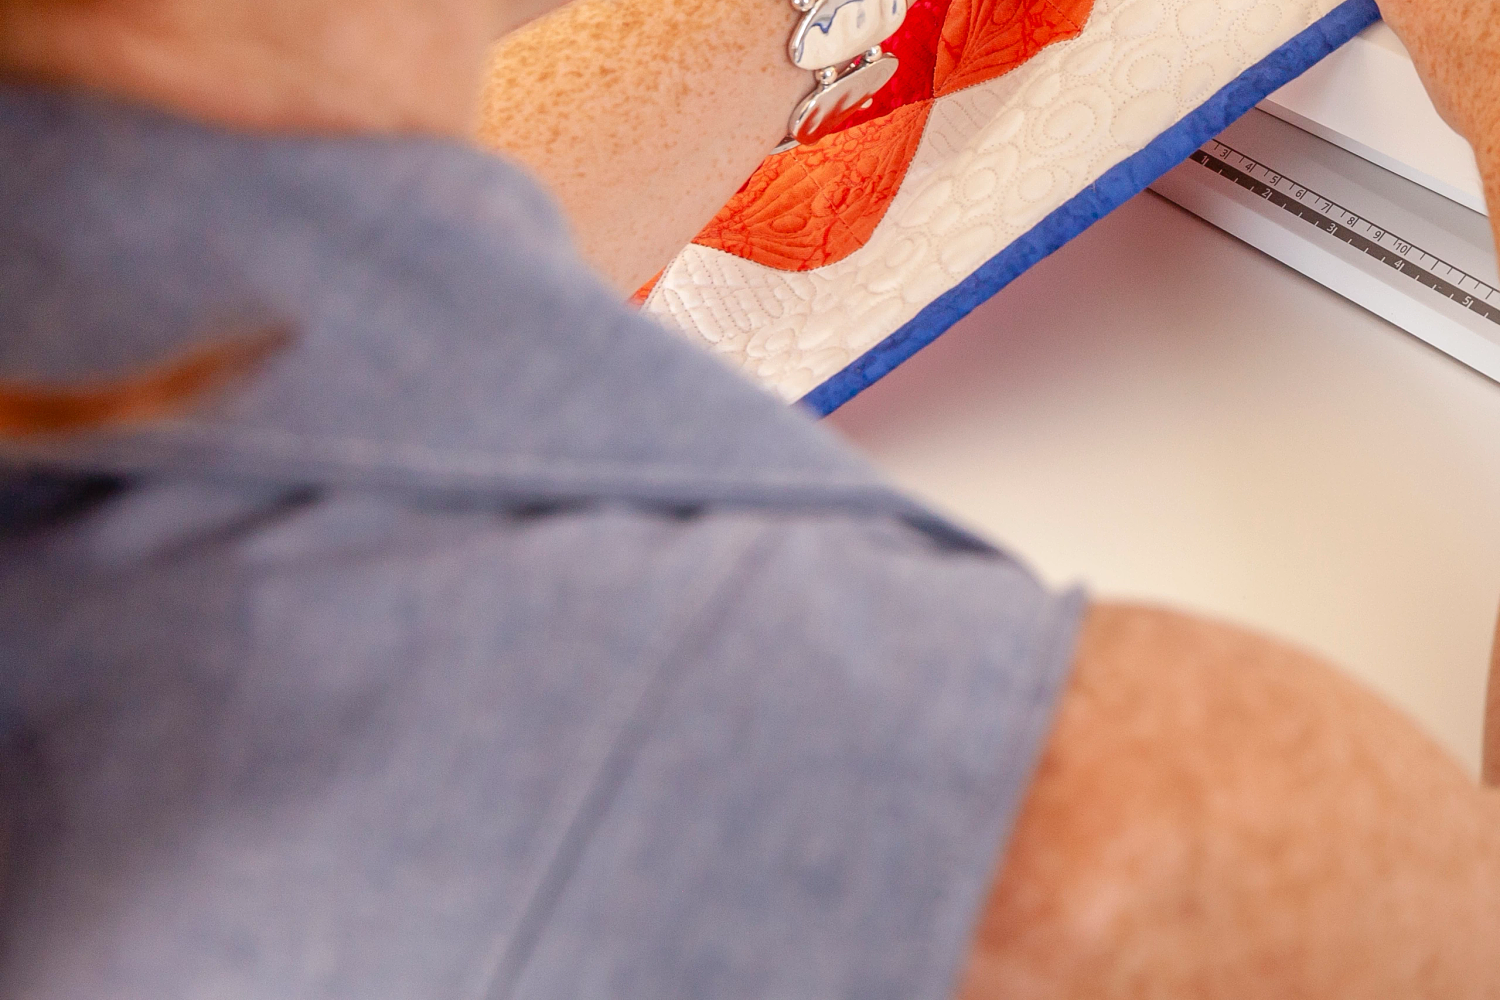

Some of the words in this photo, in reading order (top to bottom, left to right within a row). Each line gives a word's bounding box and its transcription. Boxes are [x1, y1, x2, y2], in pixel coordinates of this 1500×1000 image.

[1219, 149, 1228, 157] 3
[1245, 162, 1254, 171] 4
[1269, 175, 1278, 184] 5
[1295, 189, 1304, 198] 6
[1320, 202, 1330, 211] 7
[1346, 216, 1356, 225] 8
[1372, 230, 1382, 239] 9
[1396, 241, 1408, 253] 10
[1261, 187, 1271, 197] 2
[1327, 222, 1336, 232] 3
[1394, 260, 1403, 269] 4
[1461, 295, 1471, 305] 5
